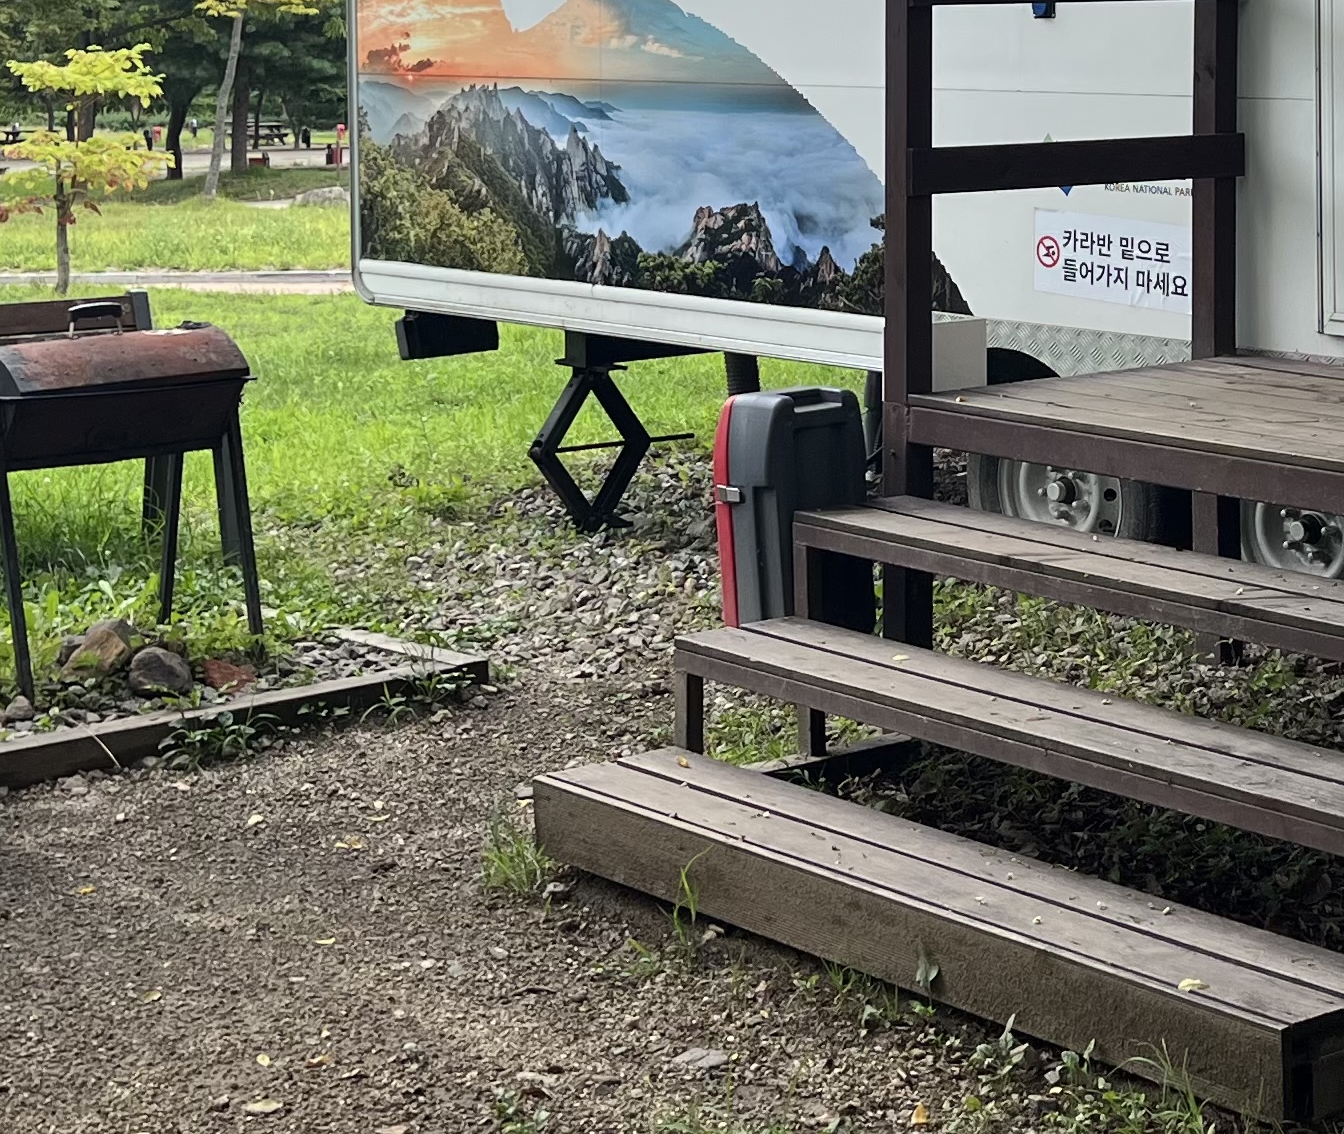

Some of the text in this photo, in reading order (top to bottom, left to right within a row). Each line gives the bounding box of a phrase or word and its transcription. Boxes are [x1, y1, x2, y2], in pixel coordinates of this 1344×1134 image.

[1132, 183, 1173, 196] NATIONAL
[1174, 186, 1193, 197] PAR
[1062, 229, 1171, 264] 카라반 밑으로
[1062, 258, 1189, 297] 들어가지 마세요
